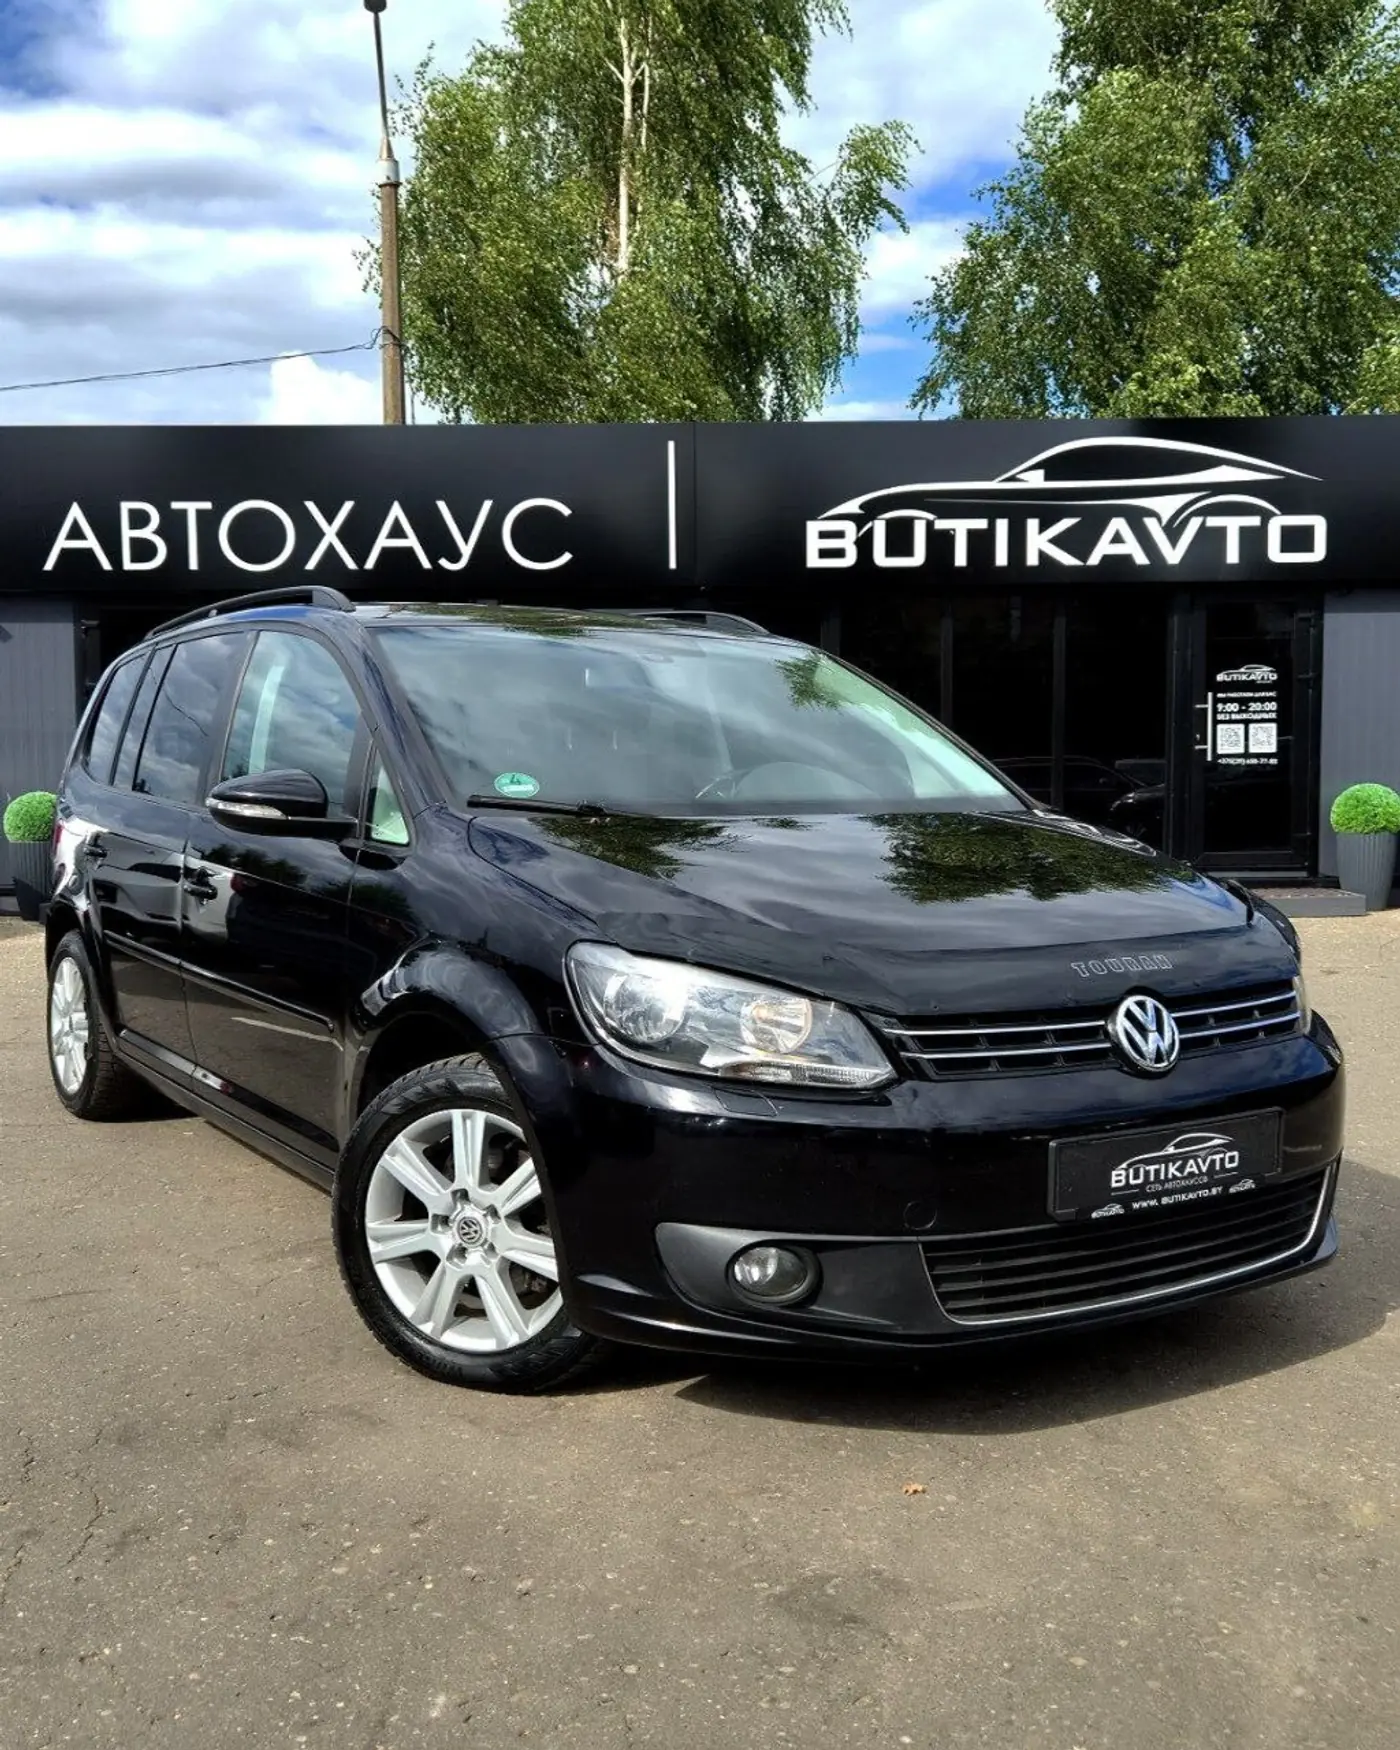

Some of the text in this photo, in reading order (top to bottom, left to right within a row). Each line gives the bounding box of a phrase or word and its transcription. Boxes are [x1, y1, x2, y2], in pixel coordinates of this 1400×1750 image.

[43, 497, 574, 573] АВТОХАУС
[805, 513, 1327, 569] BUTIKAVTO
[1216, 671, 1278, 682] BUTIKAVTO
[1216, 702, 1240, 712] 9:00
[1248, 701, 1278, 711] 20:00
[1070, 954, 1173, 978] TOURAN
[1110, 1150, 1239, 1188] BUTIKAVTO
